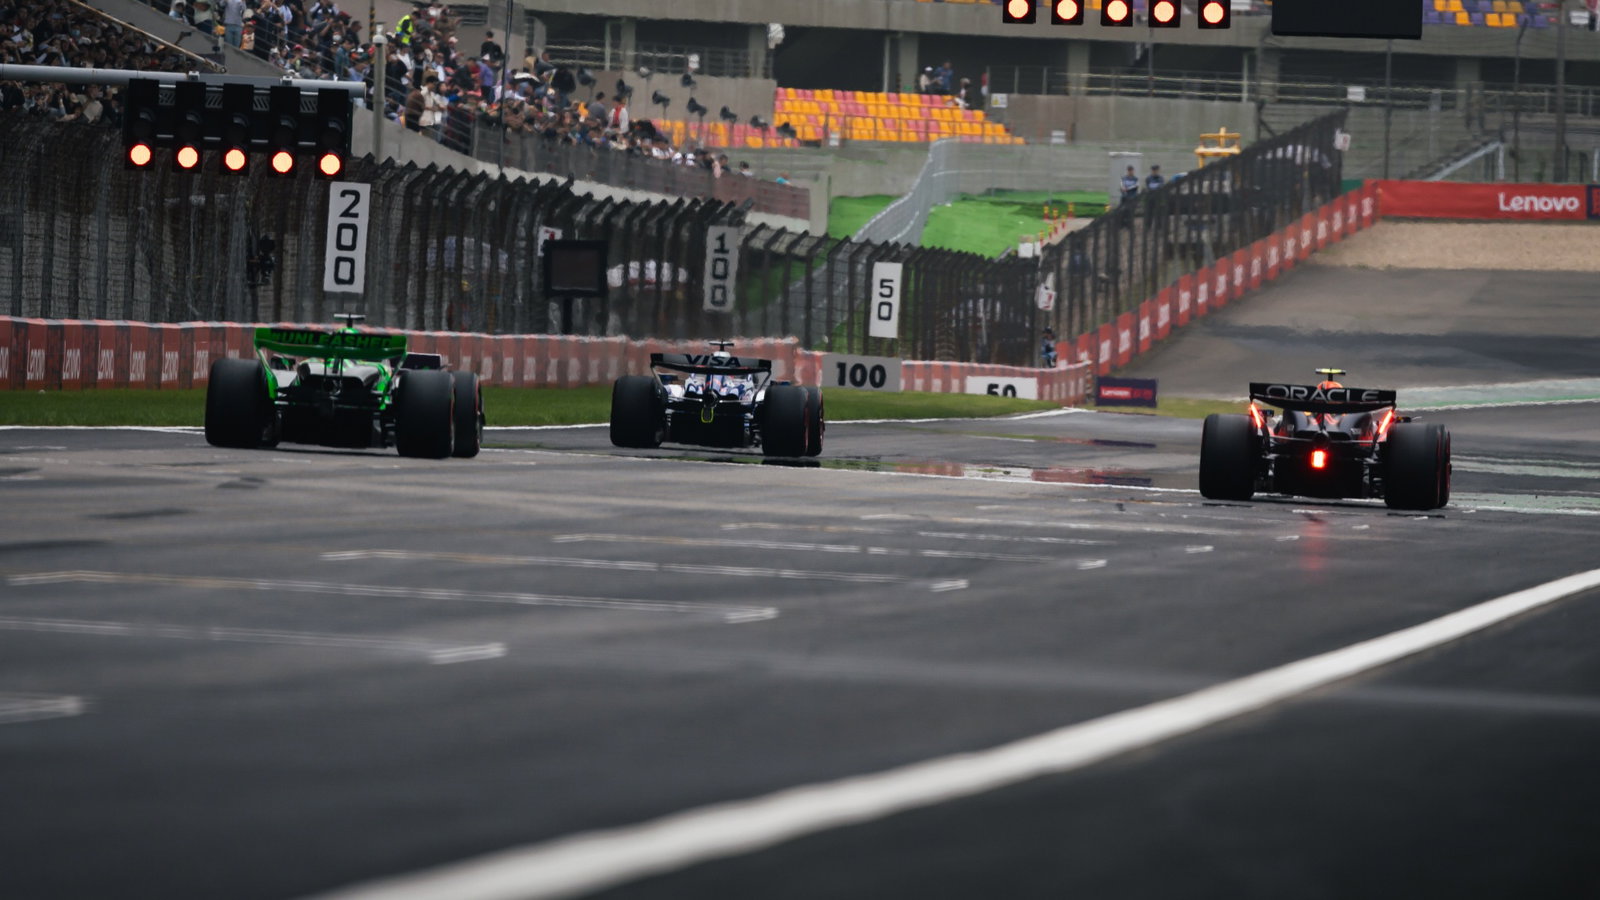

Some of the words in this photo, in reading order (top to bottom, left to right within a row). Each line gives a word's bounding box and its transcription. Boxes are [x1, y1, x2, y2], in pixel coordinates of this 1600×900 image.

[1498, 192, 1580, 212] Lenovo
[334, 189, 361, 286] 200
[711, 233, 730, 306] 100
[878, 279, 894, 321] 50
[684, 354, 741, 367] VISA
[836, 362, 886, 389] 100
[1266, 385, 1380, 403] ORACLE
